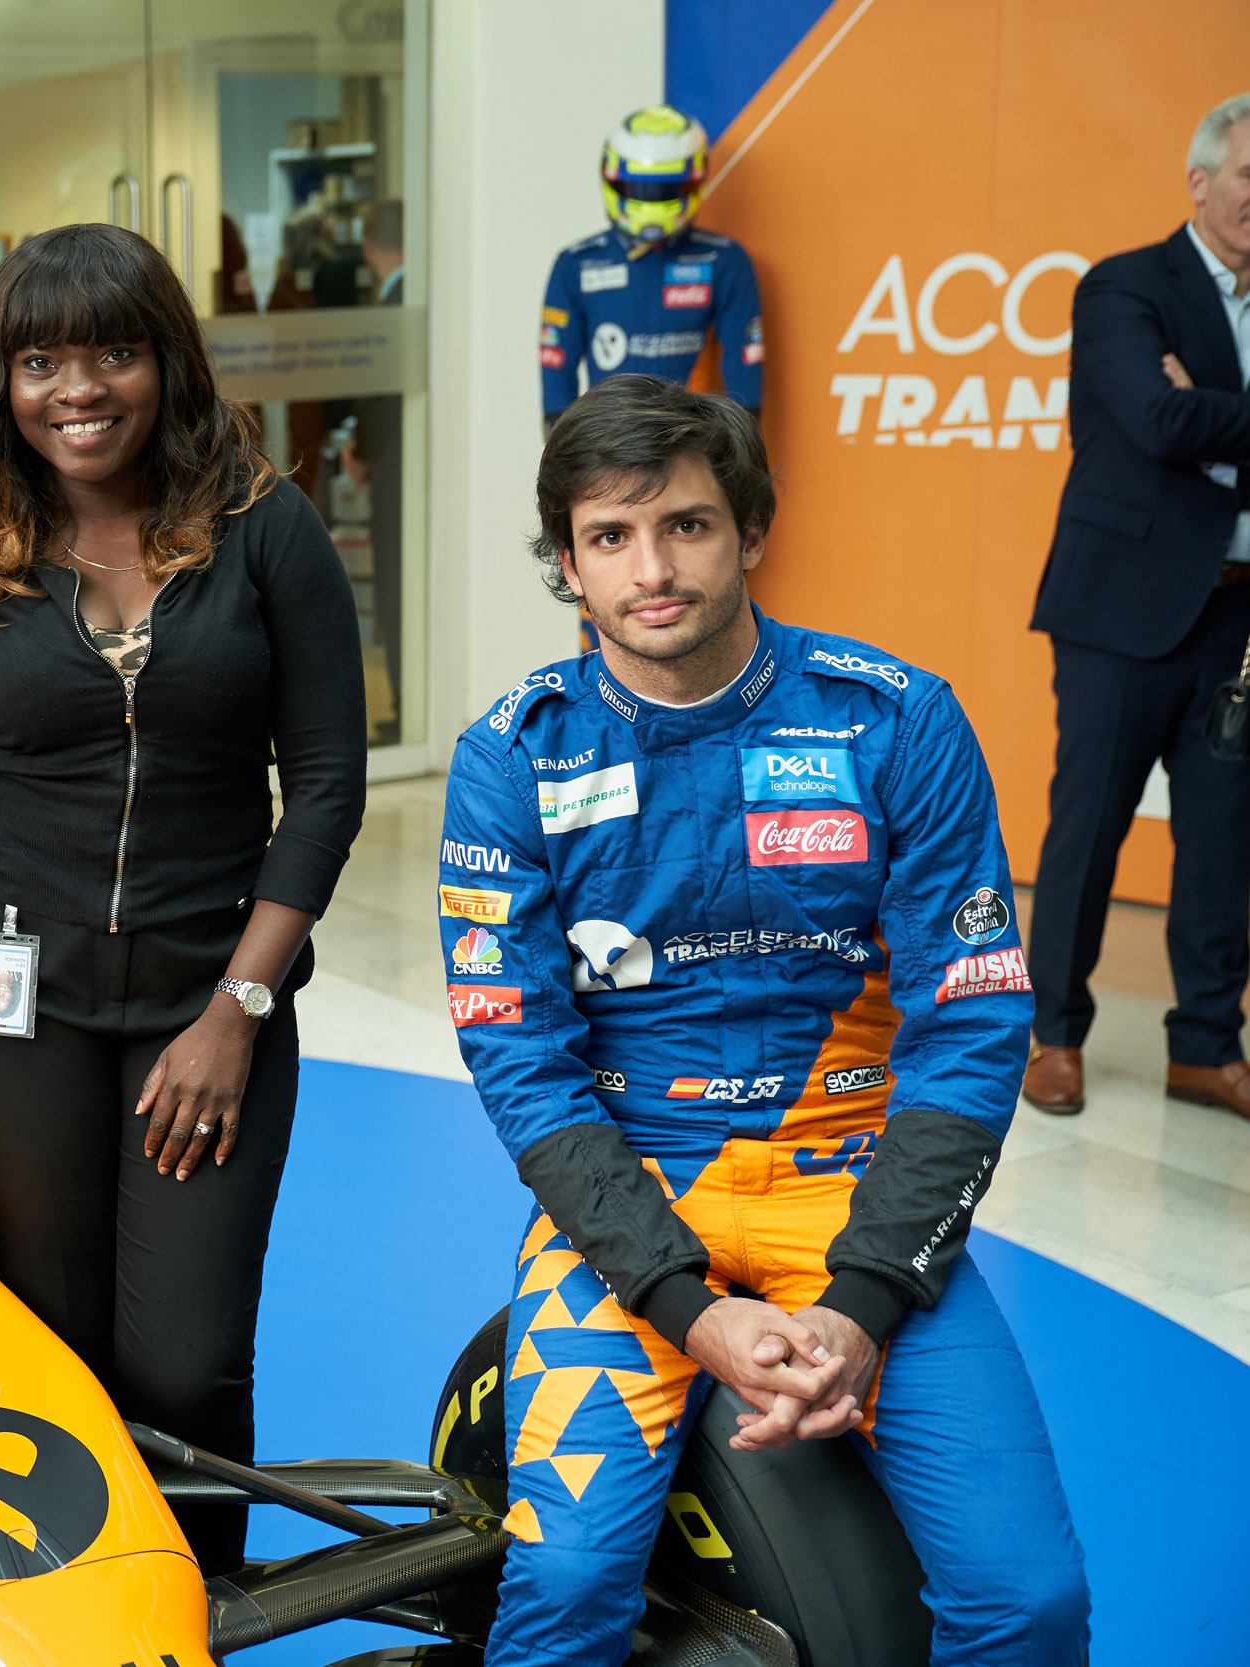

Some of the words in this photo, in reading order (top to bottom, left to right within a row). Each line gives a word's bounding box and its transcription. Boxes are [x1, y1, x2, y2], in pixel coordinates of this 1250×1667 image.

[808, 650, 908, 691] sparco
[489, 673, 564, 733] sparco
[599, 677, 633, 718] Hilton
[771, 724, 865, 739] McLaren
[766, 755, 837, 779] DELL
[563, 785, 630, 812] PETROBRAS
[769, 779, 837, 793] Technologies
[757, 818, 857, 855] Coca-Cola
[453, 962, 503, 976] CNBC
[947, 948, 1029, 987] HUSKI
[947, 976, 1032, 999] CHOCOLATE
[704, 1075, 785, 1104] CS_55
[825, 1063, 886, 1091] sparco
